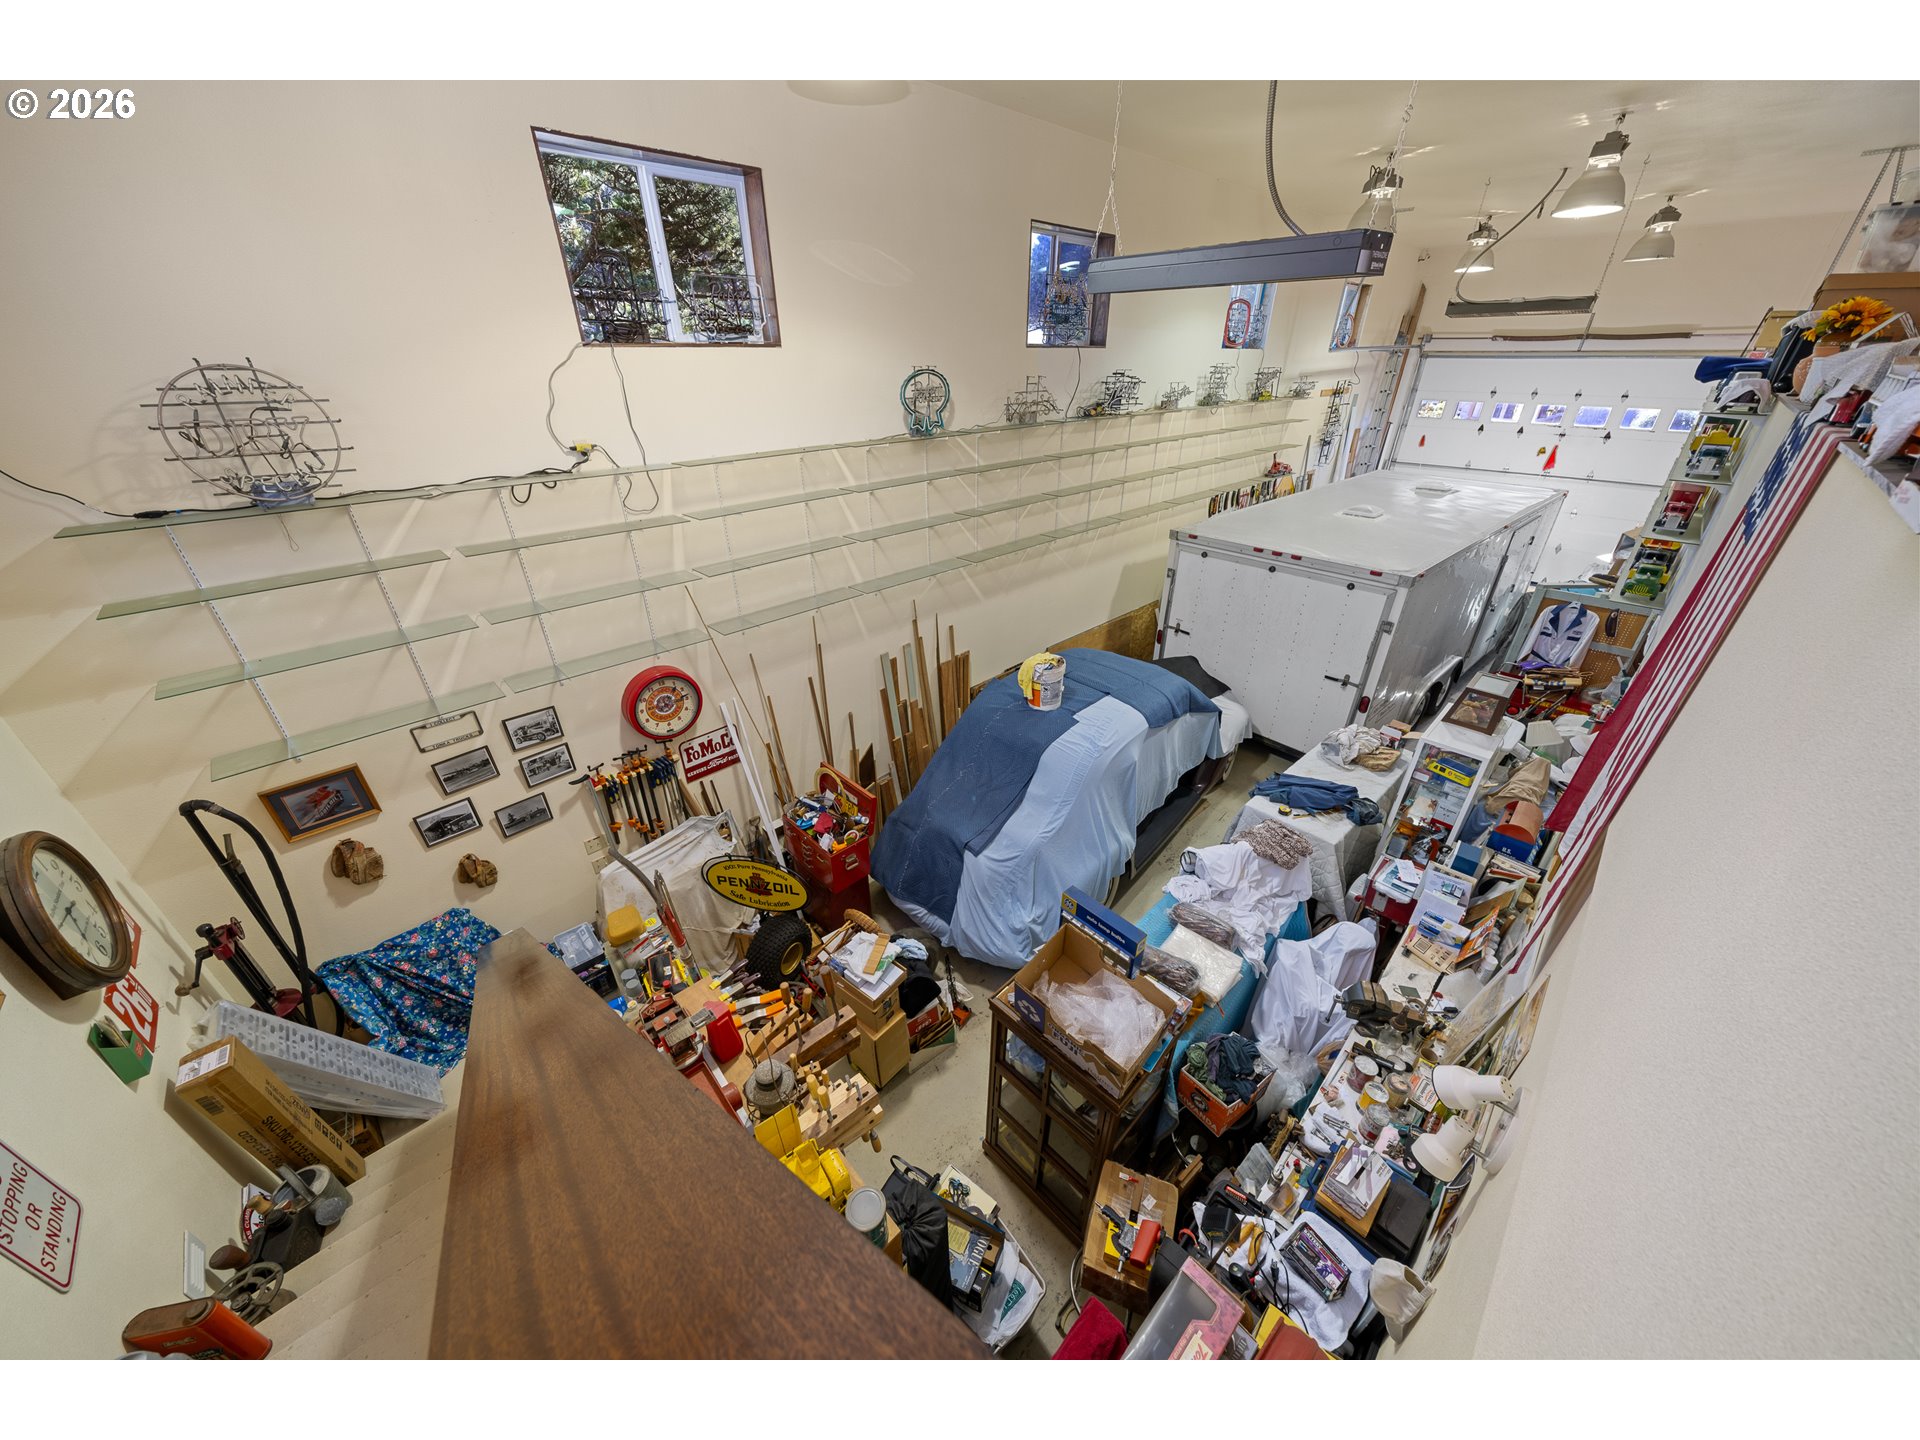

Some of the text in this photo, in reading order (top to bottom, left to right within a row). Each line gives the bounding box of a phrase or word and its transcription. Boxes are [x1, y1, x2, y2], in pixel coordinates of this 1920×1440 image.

[684, 732, 736, 763] FoMoC
[687, 766, 707, 777] GENUINE
[716, 875, 800, 896] PENNZOIL
[752, 865, 788, 882] Pennsylvania
[729, 890, 791, 908] Safe Lubrication
[1053, 1030, 1079, 1057] FUJI
[1178, 1092, 1217, 1132] KIWANDA
[0, 1162, 28, 1245] STOPPING
[25, 1202, 43, 1231] OR
[40, 1191, 67, 1273] STANDING
[967, 1235, 992, 1269] VOGUE
